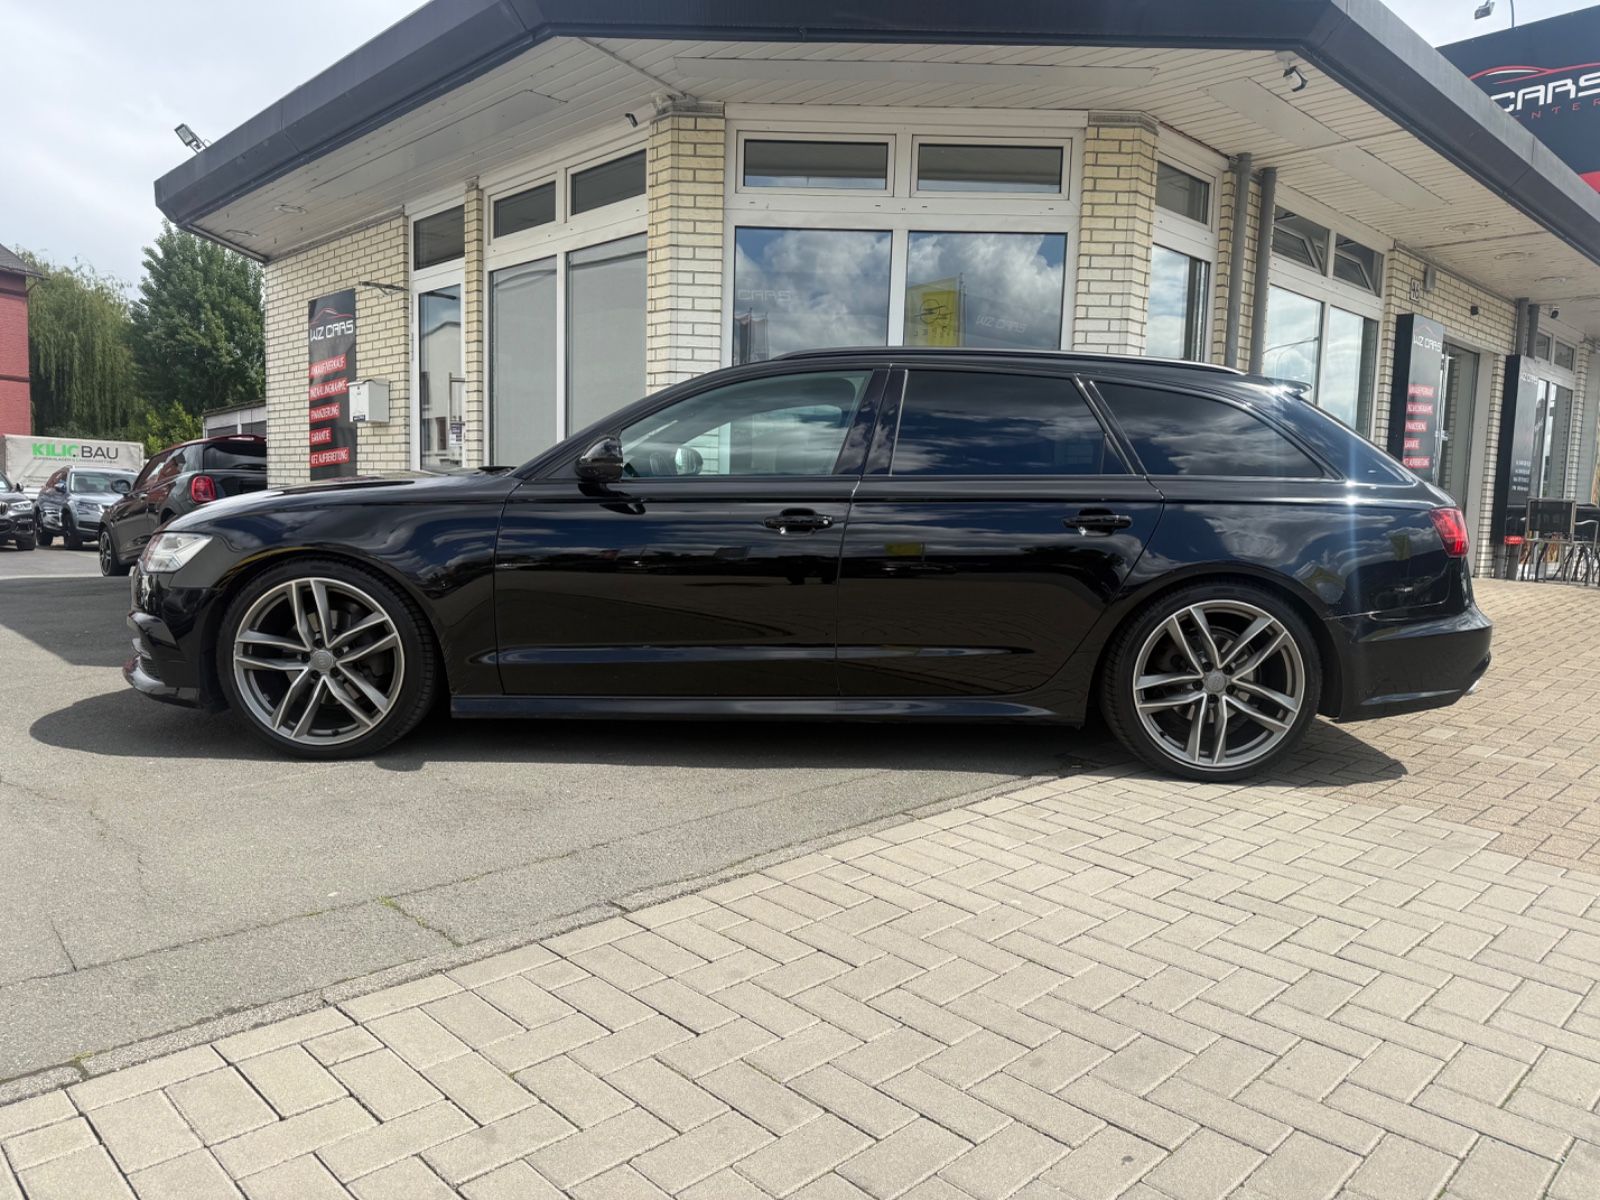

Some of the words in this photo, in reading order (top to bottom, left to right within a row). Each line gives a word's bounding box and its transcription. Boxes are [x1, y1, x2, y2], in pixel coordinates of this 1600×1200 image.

[1489, 71, 1600, 113] CARS
[1511, 98, 1600, 119] NTER
[310, 326, 324, 341] WZ
[325, 320, 354, 338] CARS
[81, 445, 119, 459] BAU
